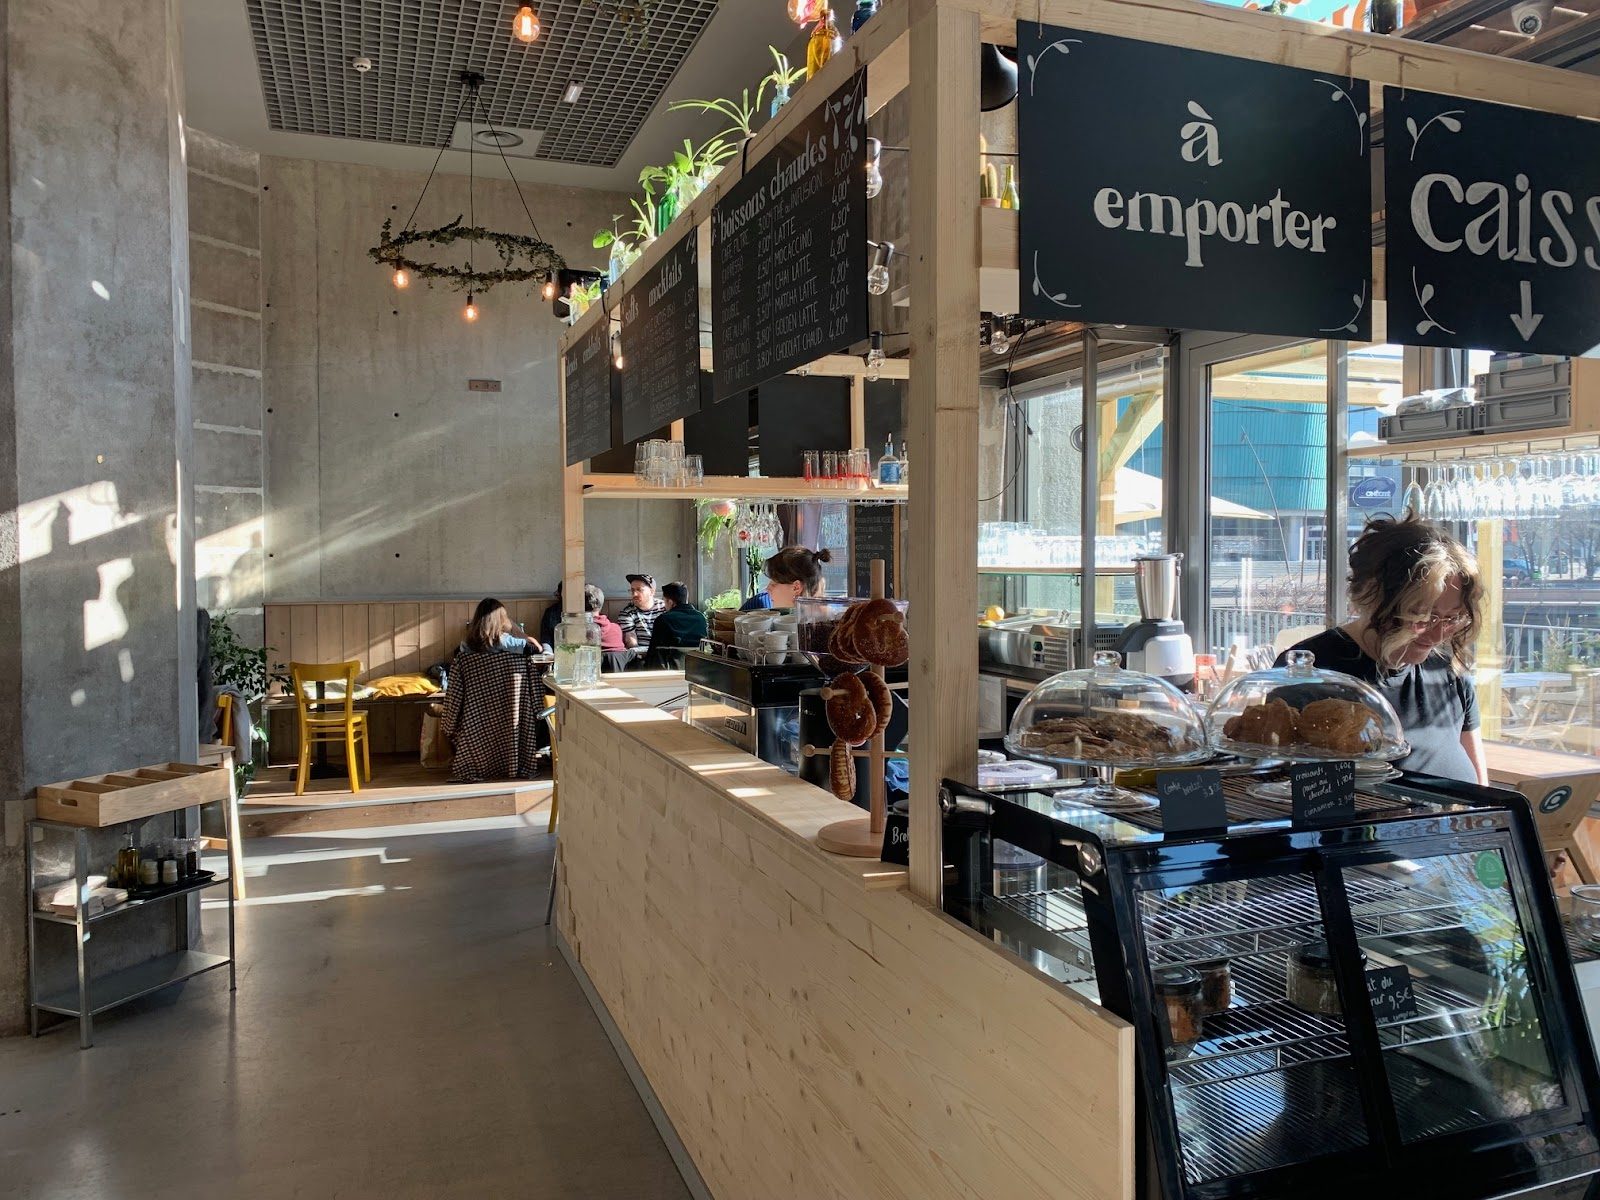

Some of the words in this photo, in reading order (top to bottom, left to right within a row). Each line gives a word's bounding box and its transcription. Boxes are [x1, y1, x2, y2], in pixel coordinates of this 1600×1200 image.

[1180, 100, 1223, 167] à
[771, 130, 826, 199] chaudes
[774, 216, 796, 245] LATTE
[1093, 187, 1337, 268] emporter
[775, 270, 789, 290] CHAI
[792, 253, 811, 281] LATTE
[799, 276, 818, 302] LATTE
[799, 301, 818, 327] LATTE
[1381, 976, 1393, 989] du
